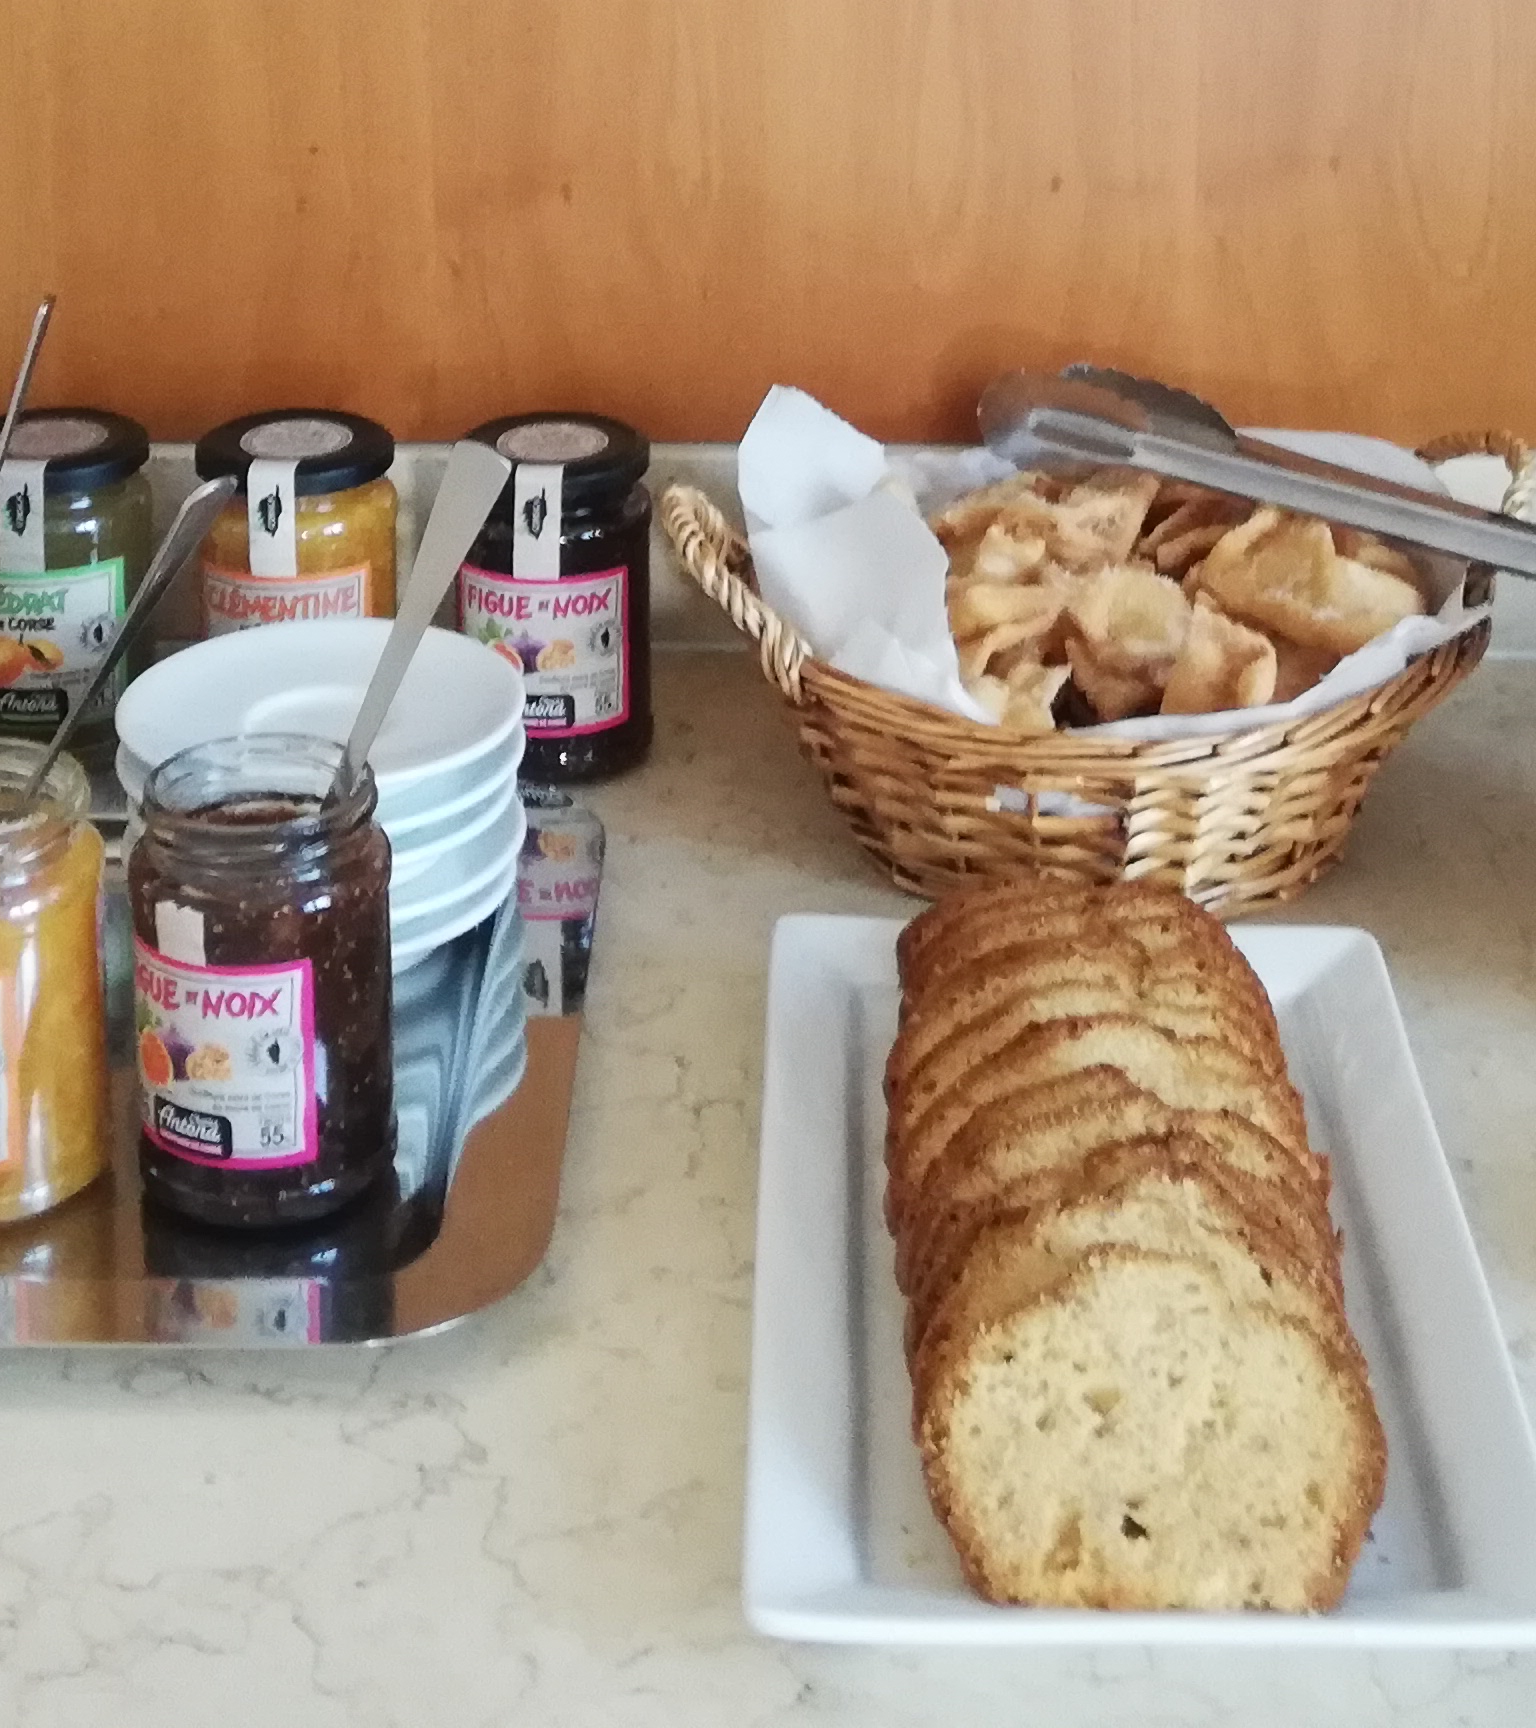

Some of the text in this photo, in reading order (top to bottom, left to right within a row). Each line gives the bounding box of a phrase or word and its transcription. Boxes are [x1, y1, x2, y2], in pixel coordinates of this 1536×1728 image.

[467, 584, 532, 620] FIGUE
[553, 587, 612, 620] NOIX
[8, 616, 56, 632] CORSE
[202, 988, 283, 1021] NOIX
